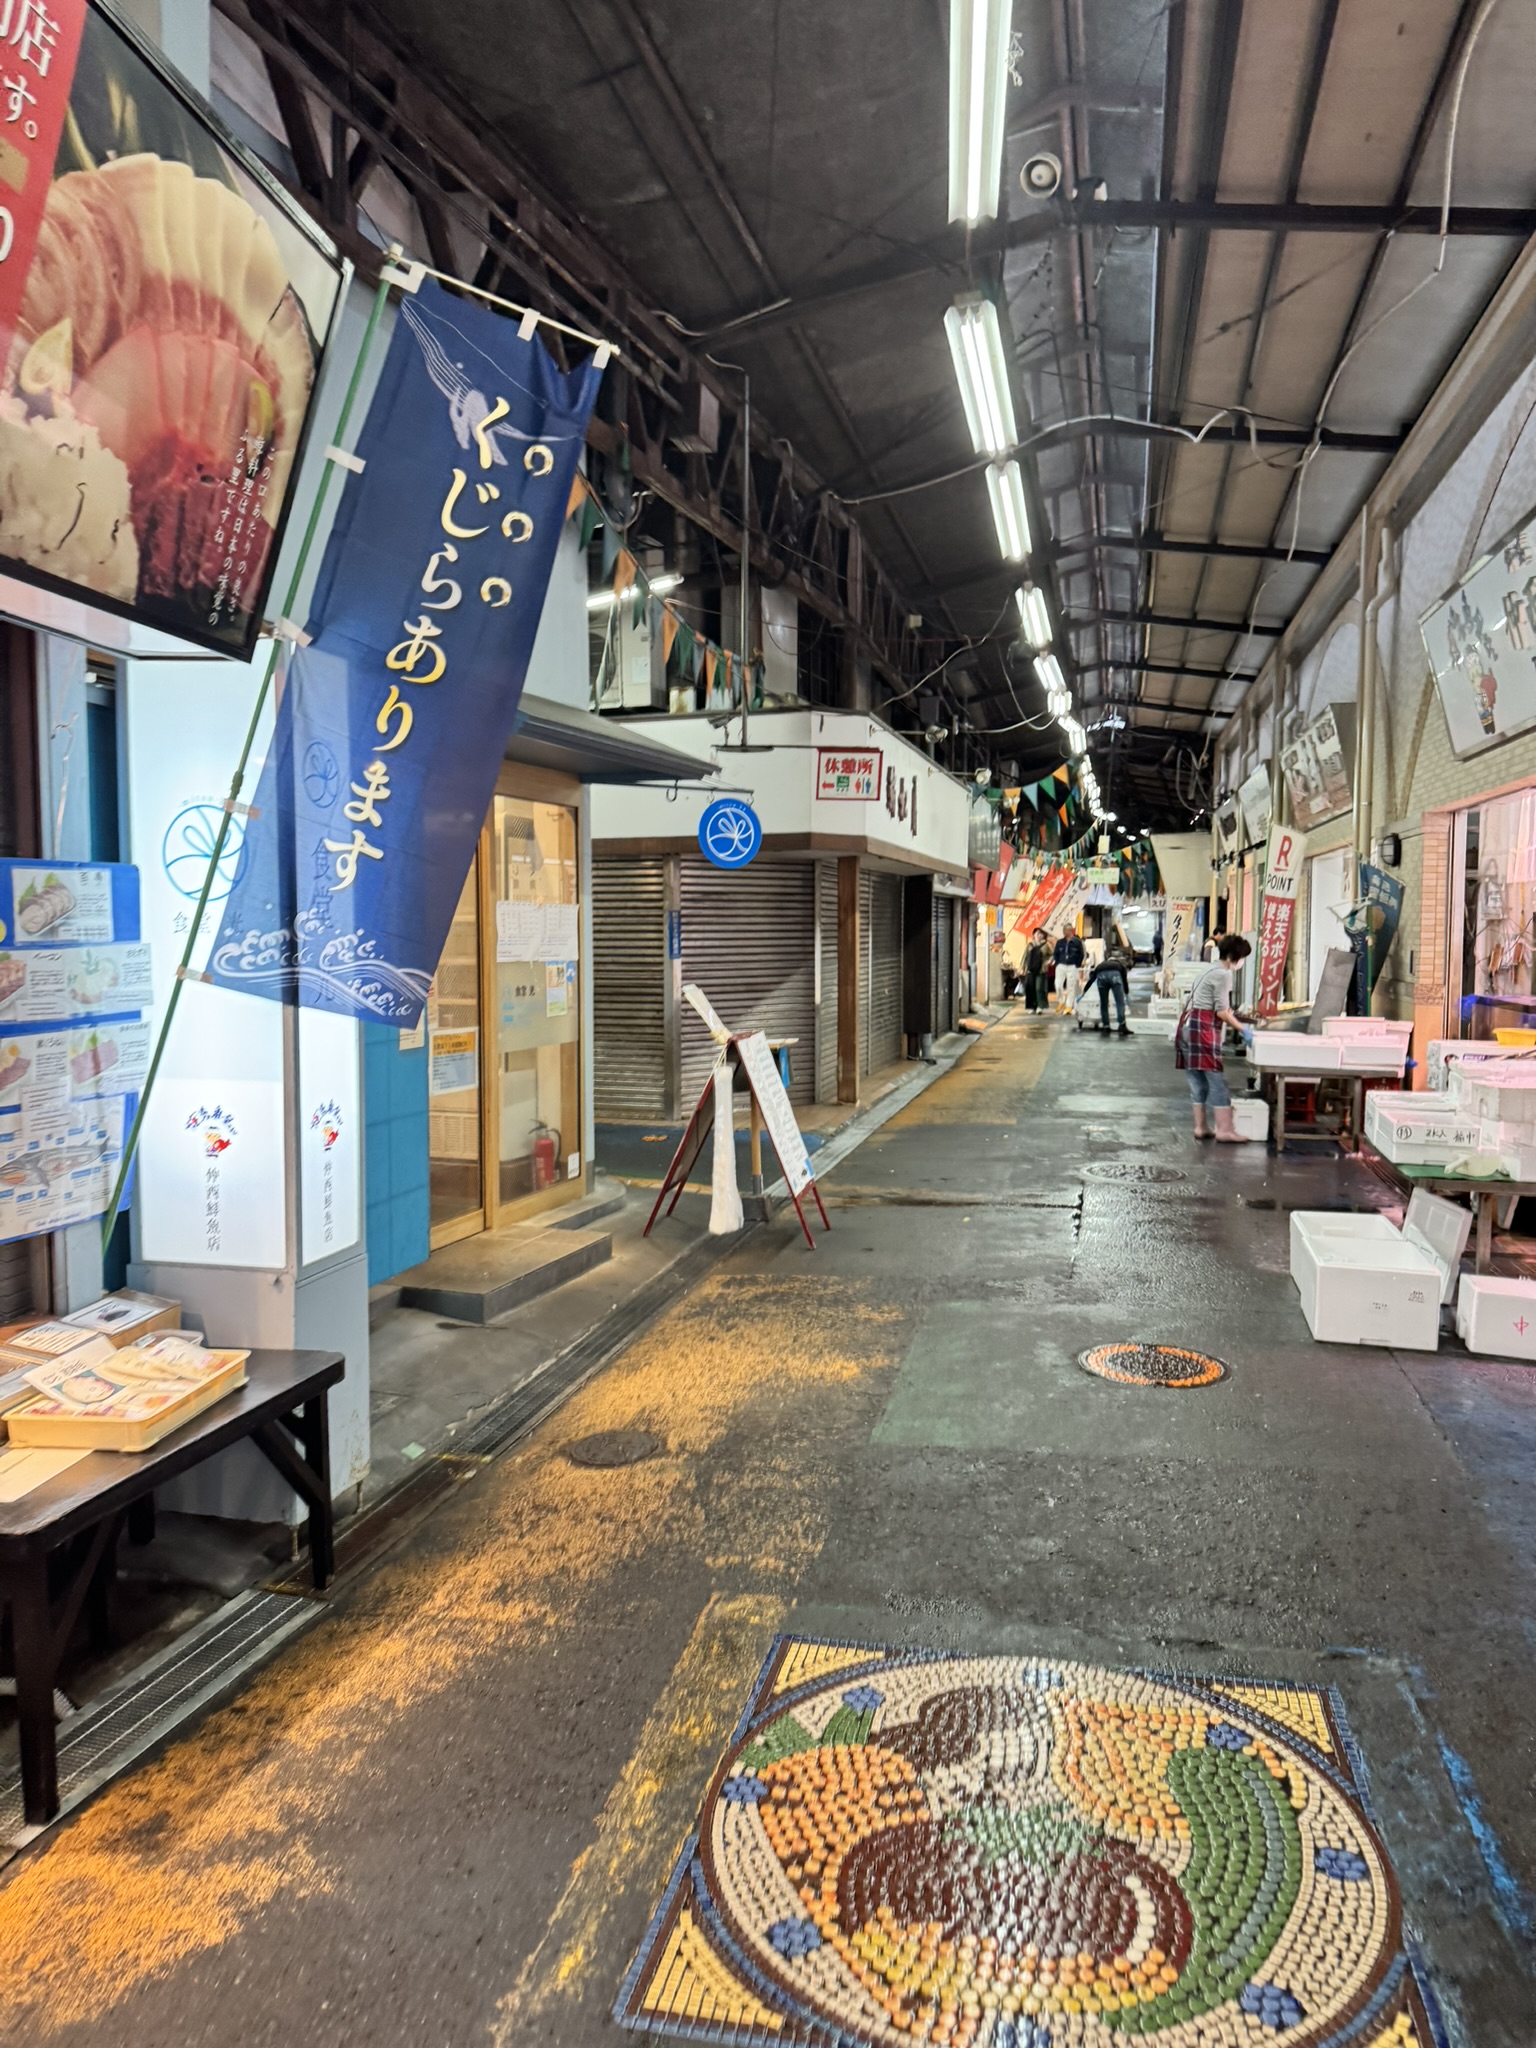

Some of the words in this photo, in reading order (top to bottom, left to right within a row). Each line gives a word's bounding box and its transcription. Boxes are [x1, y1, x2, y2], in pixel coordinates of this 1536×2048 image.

[322, 396, 511, 892] くじらあります
[1266, 872, 1294, 893] POINT
[1276, 834, 1294, 868] R
[1265, 904, 1292, 1011] 楽天ポイント
